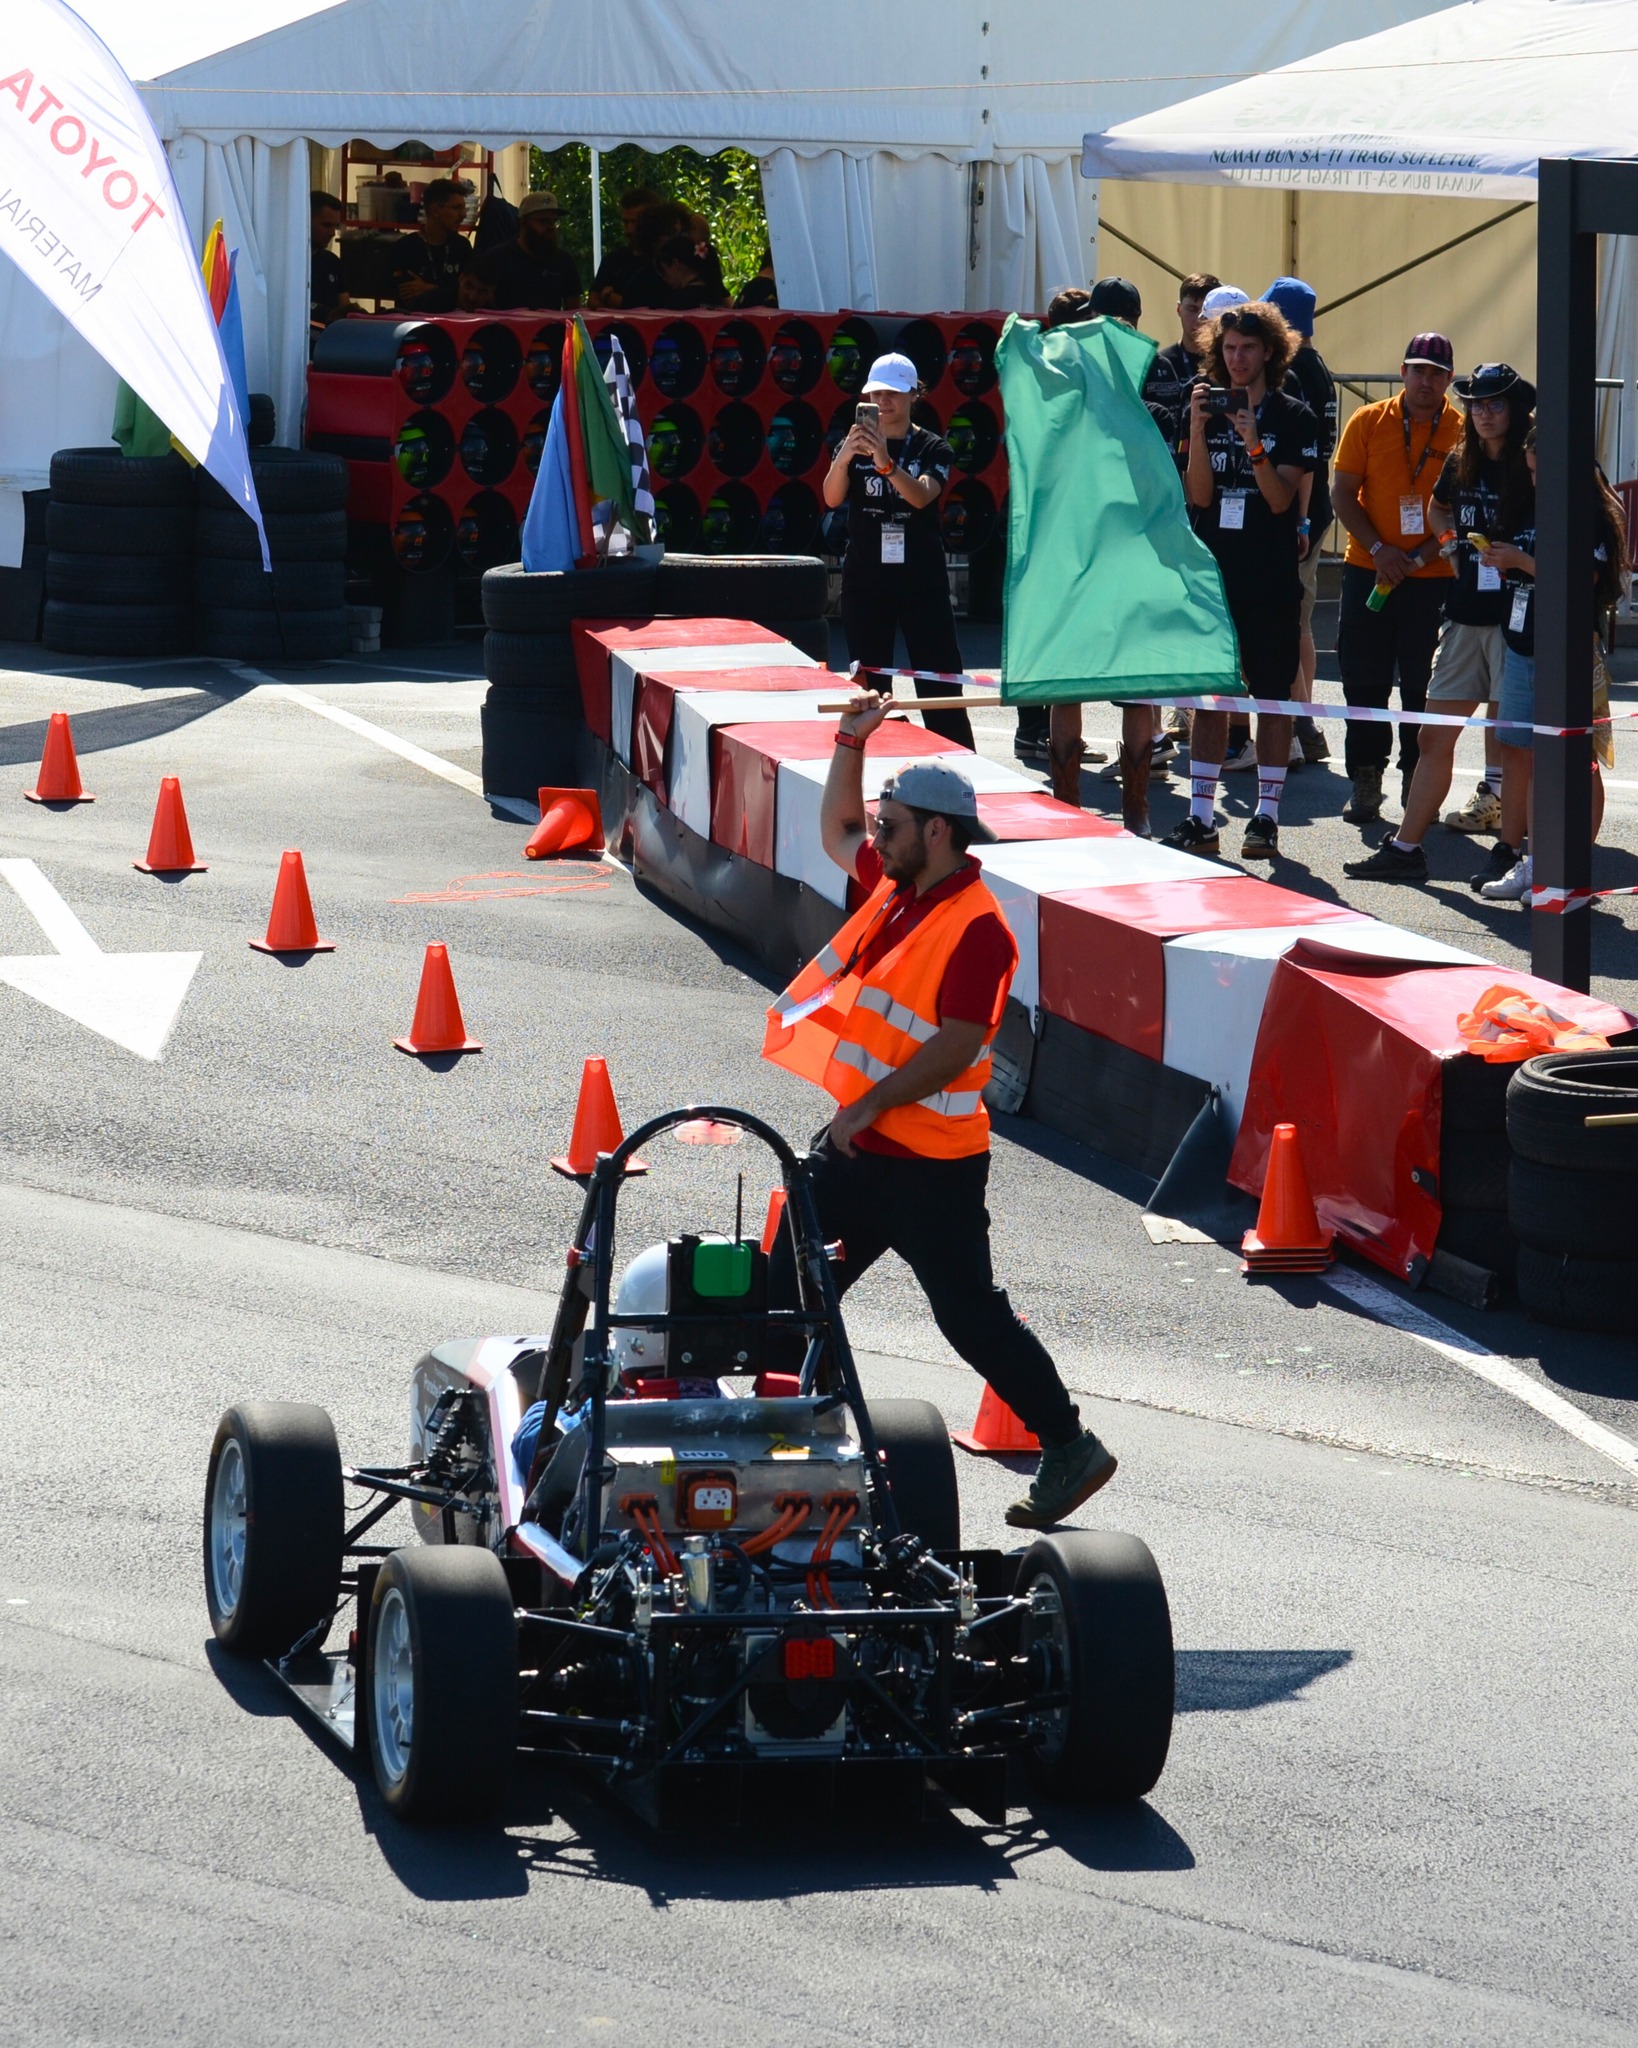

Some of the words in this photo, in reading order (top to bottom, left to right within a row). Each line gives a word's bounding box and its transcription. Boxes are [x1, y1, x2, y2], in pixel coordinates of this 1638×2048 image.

[1209, 149, 1261, 164] NUMAI
[1265, 149, 1297, 163] BUN
[1349, 149, 1396, 164] TRAGI
